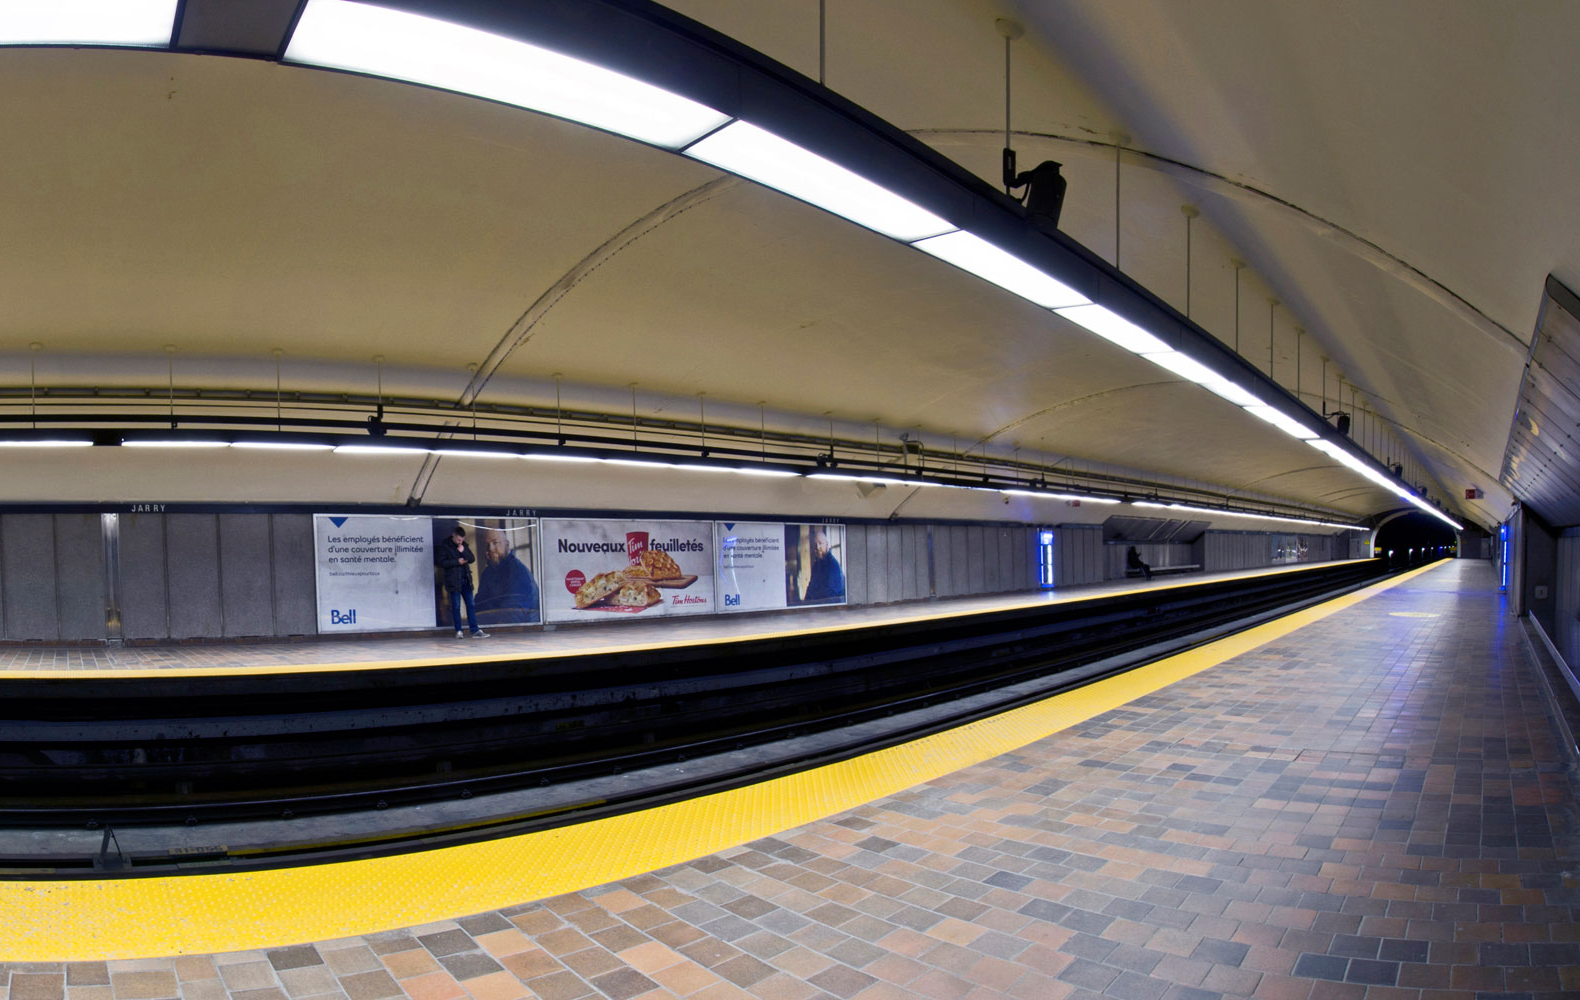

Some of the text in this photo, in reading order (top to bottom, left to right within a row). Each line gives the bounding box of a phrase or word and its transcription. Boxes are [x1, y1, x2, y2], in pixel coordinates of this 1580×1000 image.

[131, 504, 165, 513] JARRY
[506, 509, 537, 517] JARRY
[327, 535, 424, 546] Les employés bénéficient
[558, 538, 704, 553] Nouveaux feuilletés
[627, 537, 643, 553] Tim
[394, 545, 424, 553] illimitée
[340, 555, 361, 563] santé
[363, 555, 397, 563] mentale.
[672, 595, 683, 605] Tim
[725, 594, 740, 606] Bell
[331, 609, 356, 624] Bell
